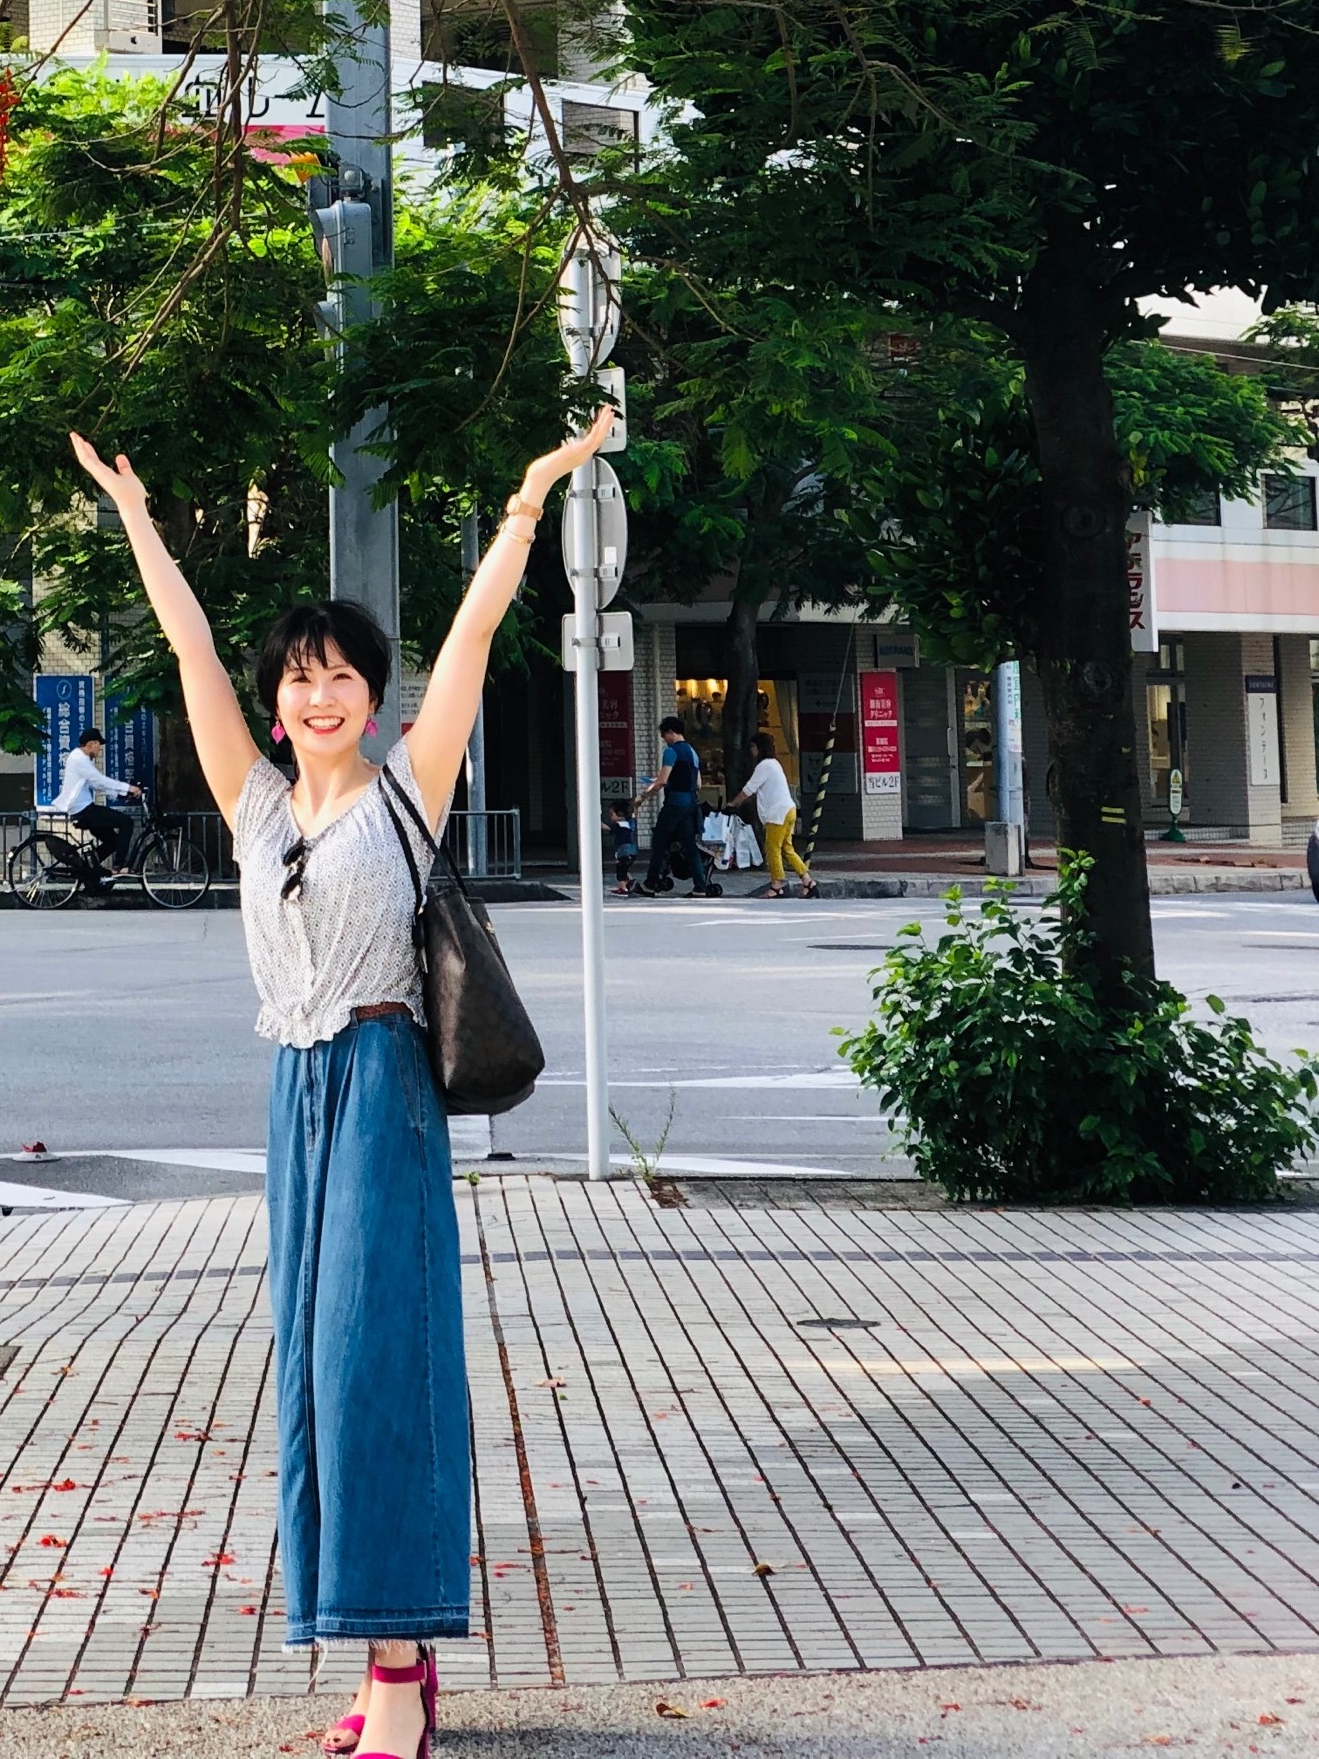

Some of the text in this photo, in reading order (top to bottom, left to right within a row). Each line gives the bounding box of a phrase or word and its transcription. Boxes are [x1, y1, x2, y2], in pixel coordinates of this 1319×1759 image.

[58, 701, 70, 793] 総合資格
[868, 775, 899, 788] 当ビル2F
